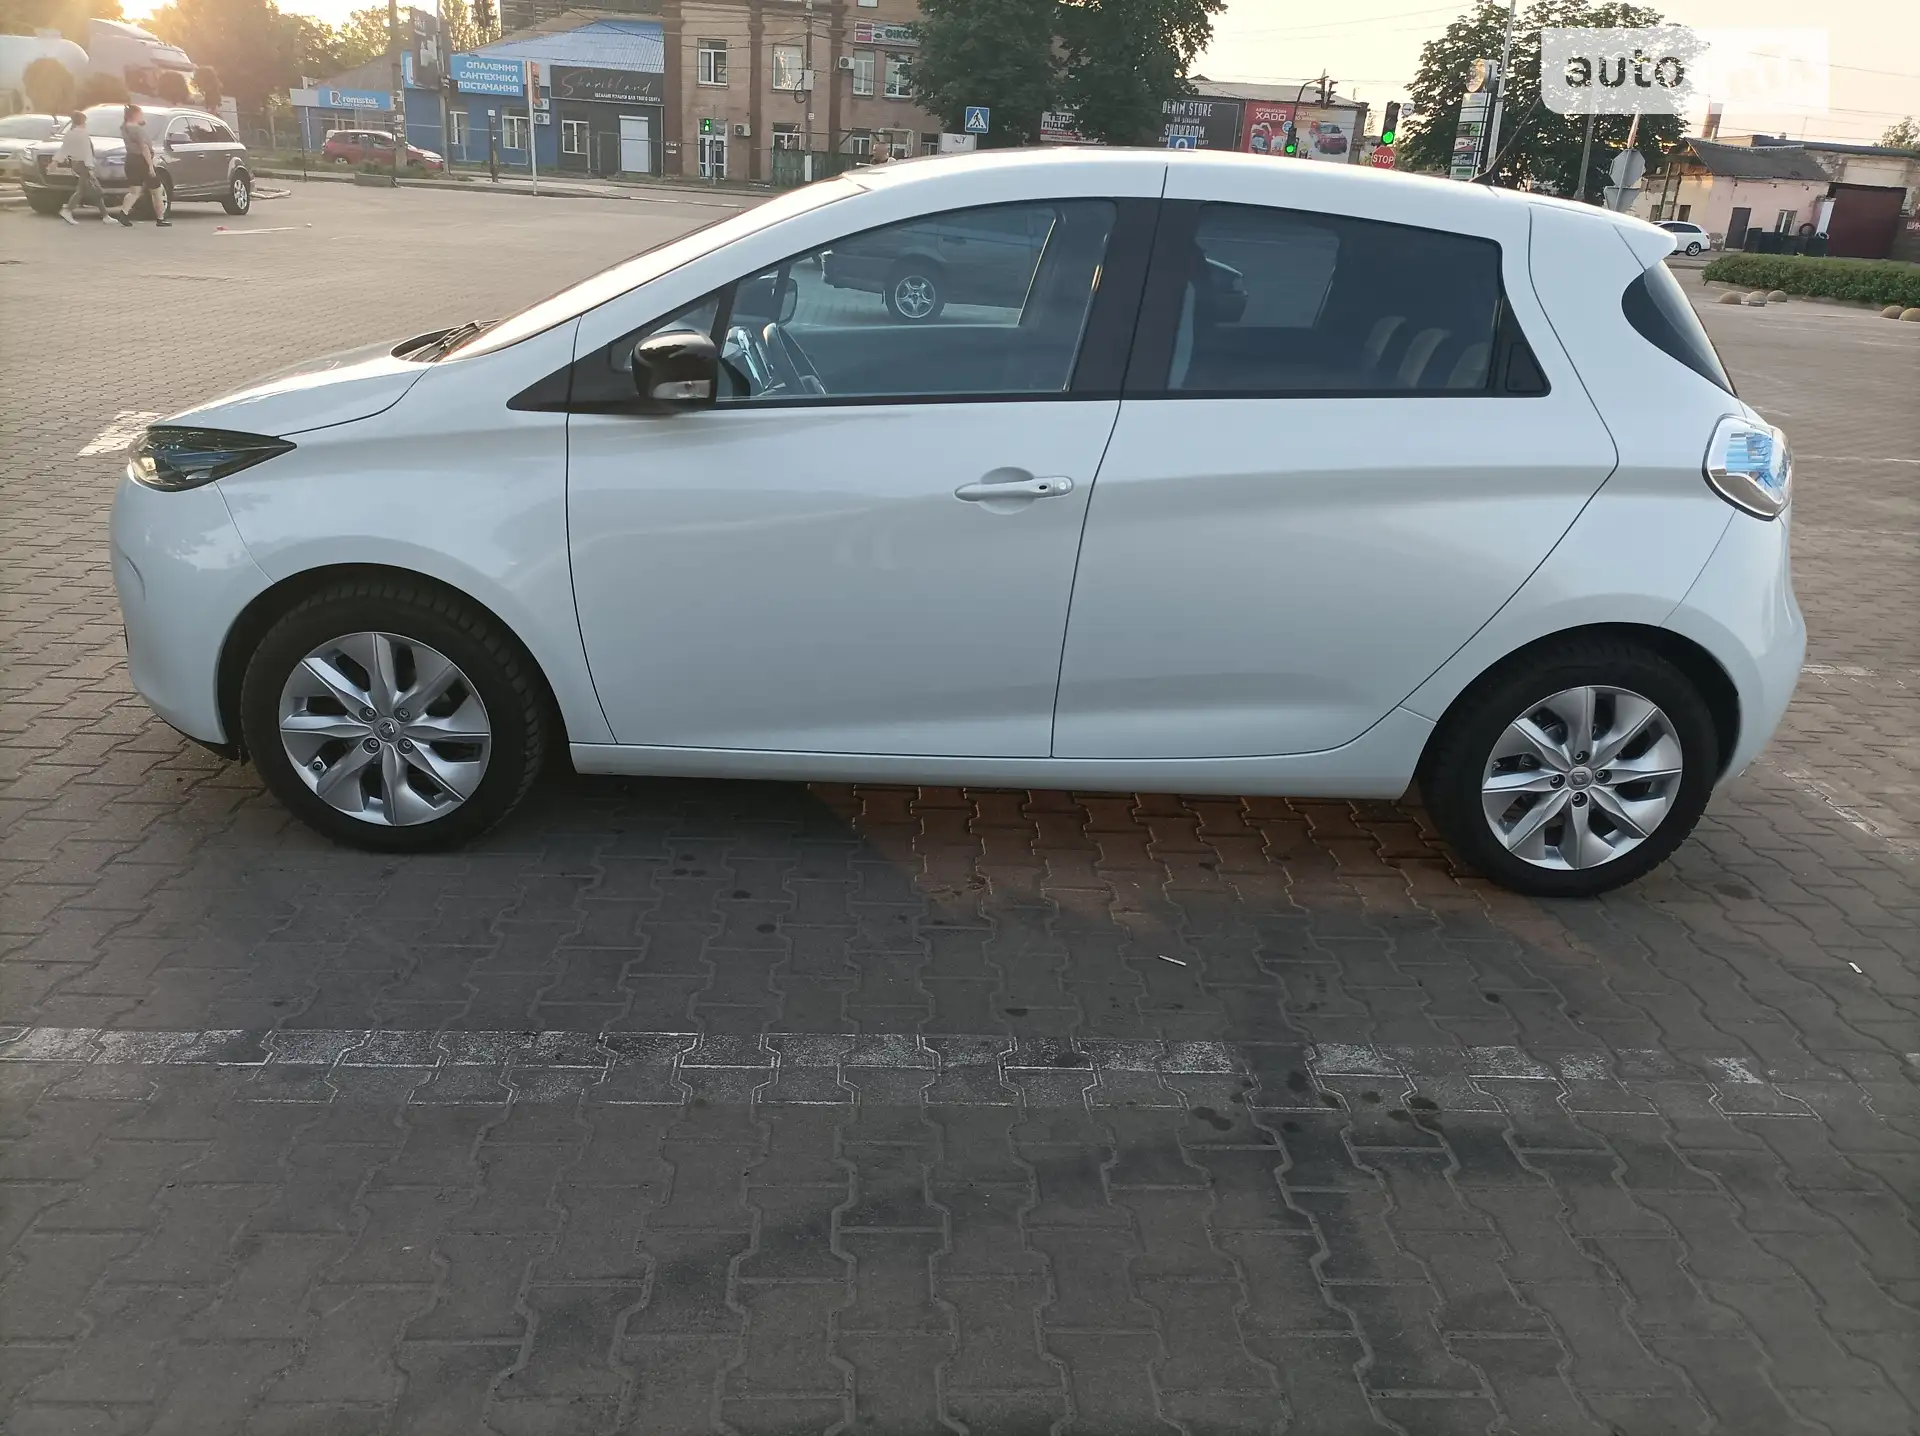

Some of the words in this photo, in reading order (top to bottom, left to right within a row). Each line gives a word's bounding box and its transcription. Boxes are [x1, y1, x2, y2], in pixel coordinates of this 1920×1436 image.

[466, 61, 518, 72] ОПАЛЕННЯ
[460, 71, 519, 82] САНТЕХНІКА
[457, 81, 519, 93] ПОСТАЧАННЯ
[1162, 100, 1186, 115] DENIM
[1189, 102, 1213, 117] STORE
[1164, 124, 1205, 138] SHOWROOM
[1373, 154, 1395, 164] STOP
